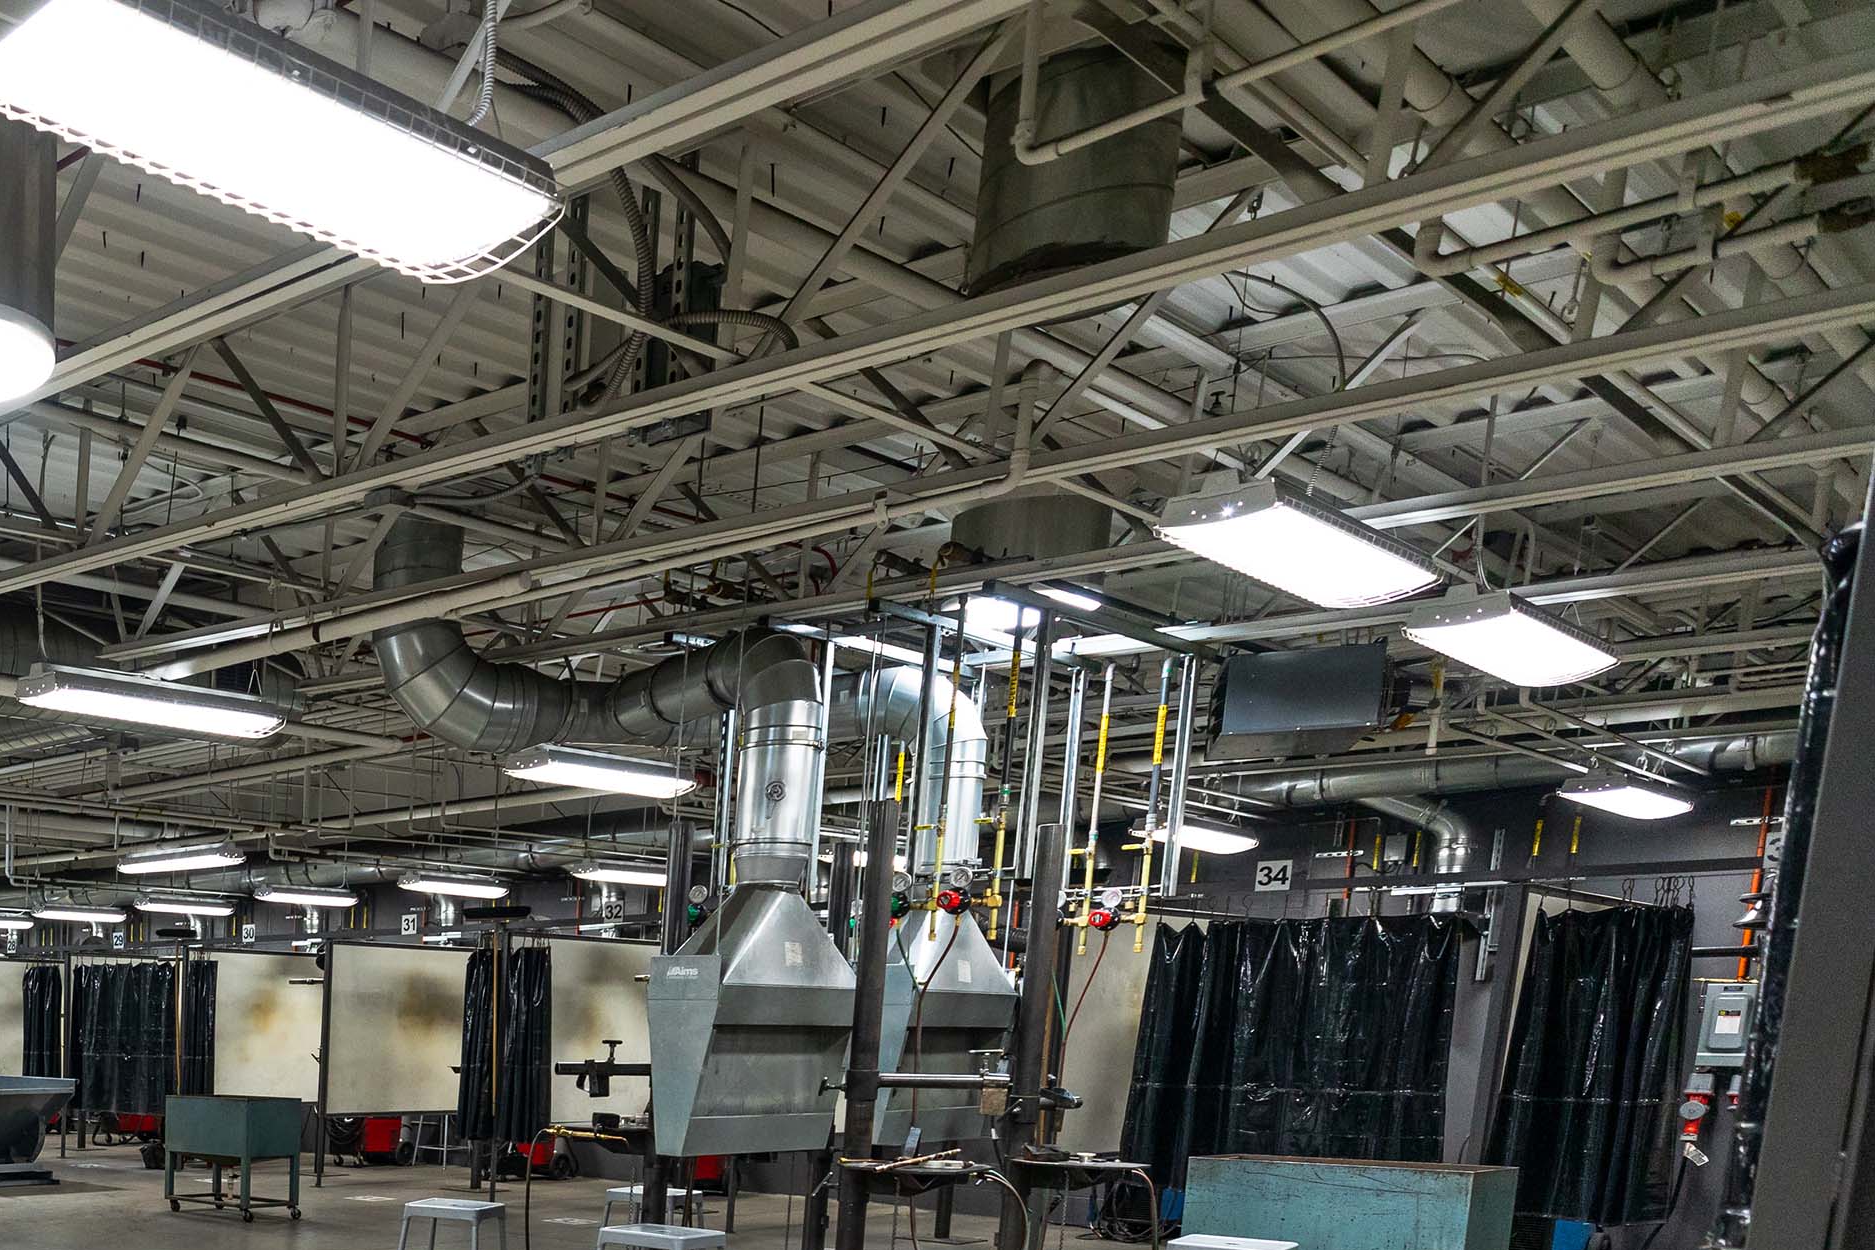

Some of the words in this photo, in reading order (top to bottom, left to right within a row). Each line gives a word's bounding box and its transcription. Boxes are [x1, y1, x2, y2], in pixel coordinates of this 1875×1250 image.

[1257, 864, 1289, 886] 34
[605, 903, 623, 920] 32
[403, 917, 417, 932] 31
[114, 934, 124, 946] 29
[243, 927, 255, 940] 30
[7, 940, 17, 951] 28
